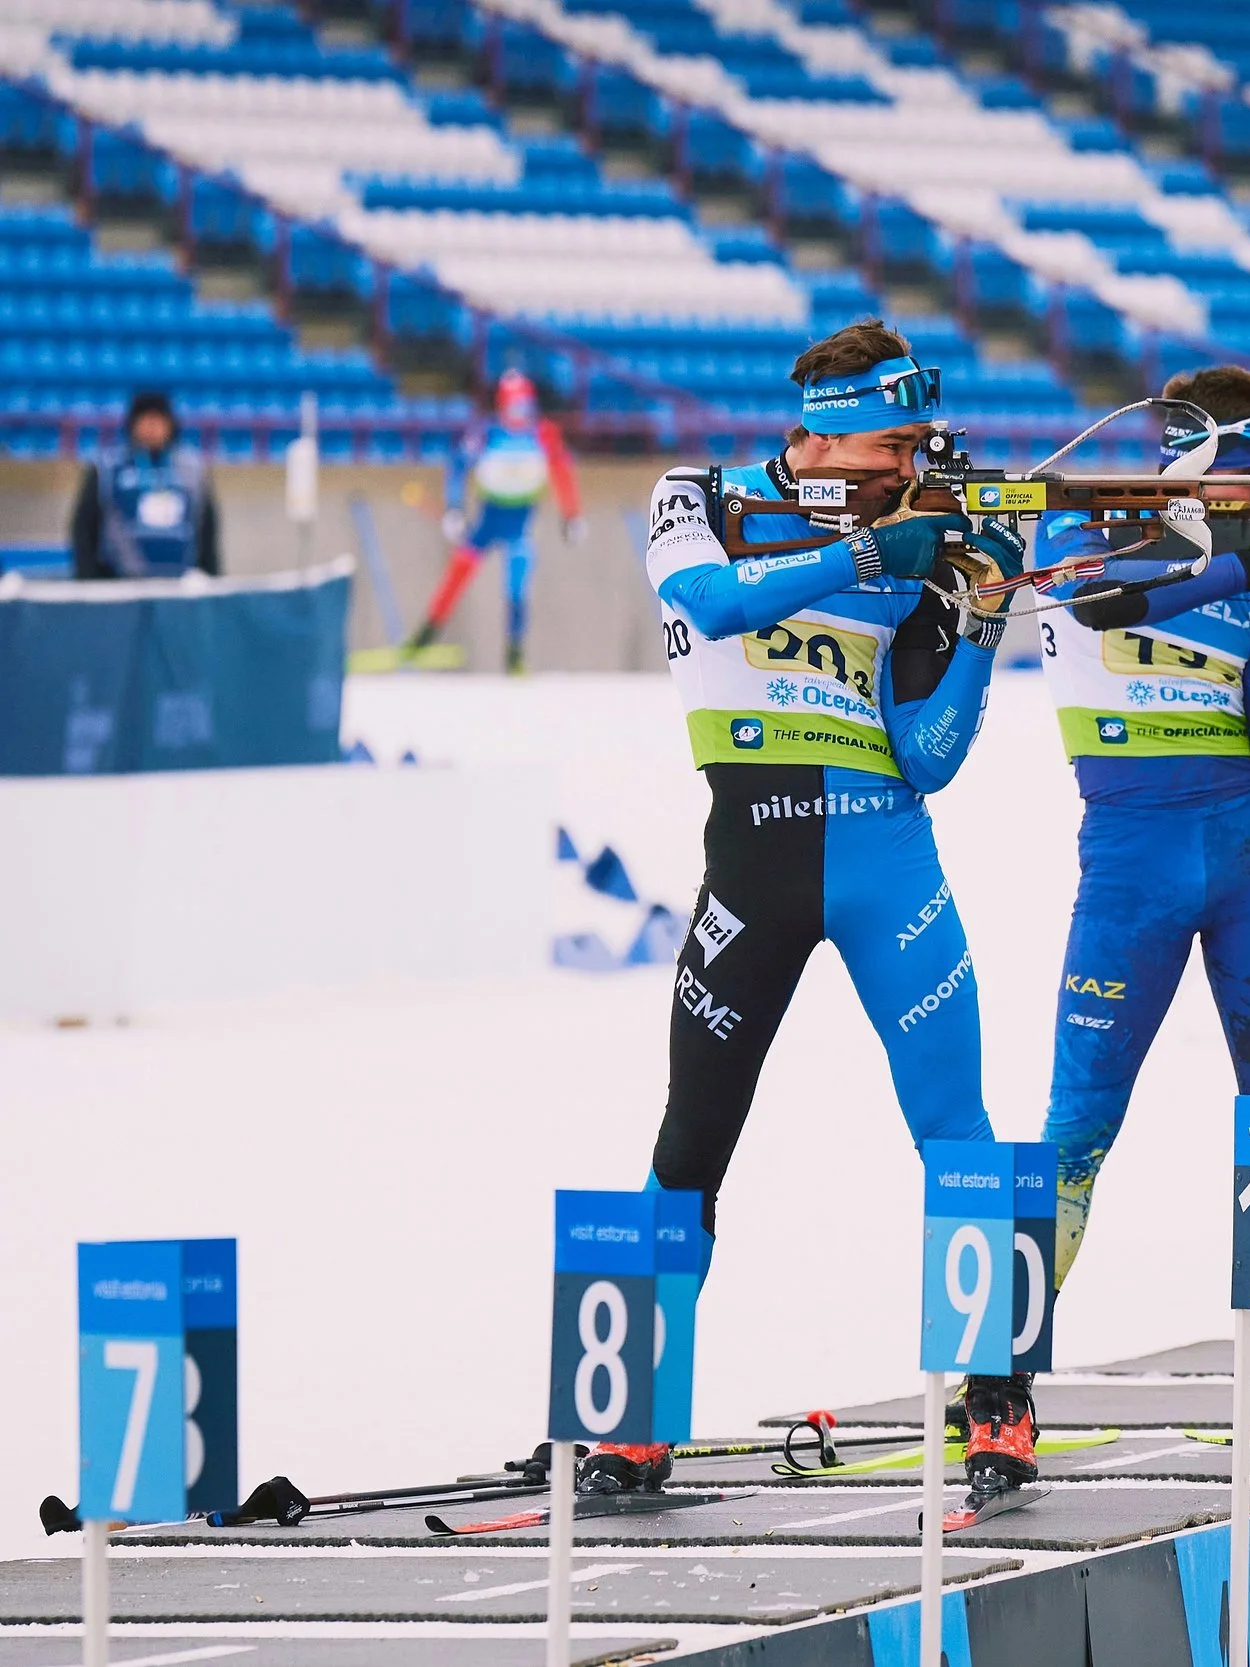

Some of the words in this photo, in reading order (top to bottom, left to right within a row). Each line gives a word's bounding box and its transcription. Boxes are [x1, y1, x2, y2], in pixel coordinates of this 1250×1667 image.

[803, 385, 856, 399] LEXELA
[803, 485, 841, 500] REME
[764, 554, 818, 568] LAPUA
[663, 619, 691, 660] 20
[1041, 622, 1057, 657] 3
[773, 729, 800, 741] THE
[804, 731, 867, 750] OFFICIAL
[931, 730, 960, 759] VILLA
[1163, 727, 1221, 737] OFFICIAL
[750, 789, 894, 826] piletilevi
[702, 911, 732, 946] iizi
[1066, 974, 1126, 999] KAZ
[676, 965, 742, 1041] REME
[938, 1172, 961, 1187] visit
[962, 1174, 1000, 1189] estonia
[569, 1224, 594, 1241] visit
[596, 1225, 640, 1243] estonia
[945, 1224, 992, 1365] 9
[574, 1280, 629, 1434] 8
[104, 1340, 158, 1513] 7
